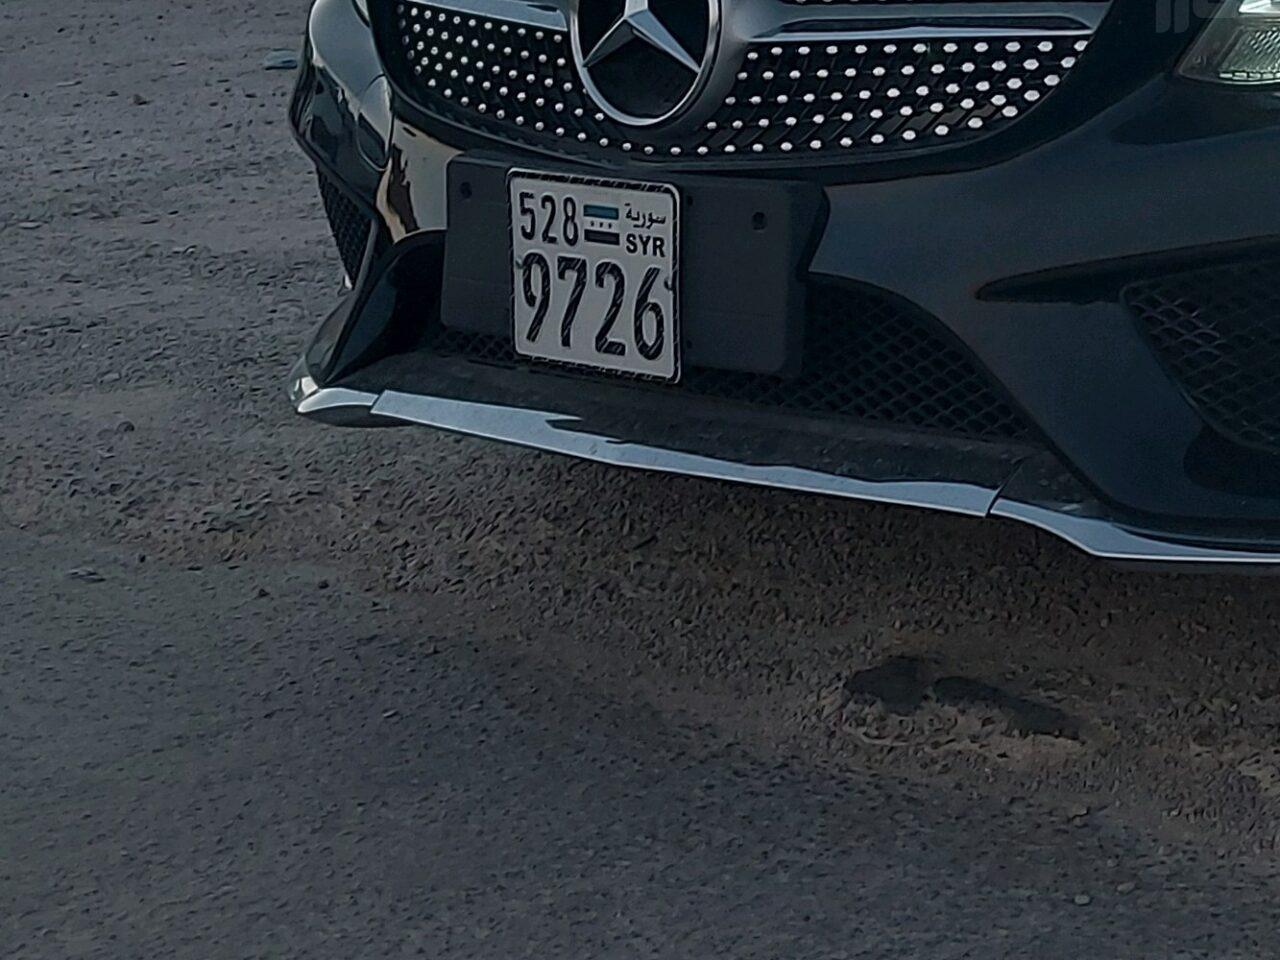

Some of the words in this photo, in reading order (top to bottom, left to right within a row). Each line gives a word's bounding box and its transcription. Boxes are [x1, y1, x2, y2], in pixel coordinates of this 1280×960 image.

[519, 191, 579, 246] 528
[624, 202, 666, 230] سورية
[626, 233, 666, 258] SYR
[521, 252, 665, 361] 9726
